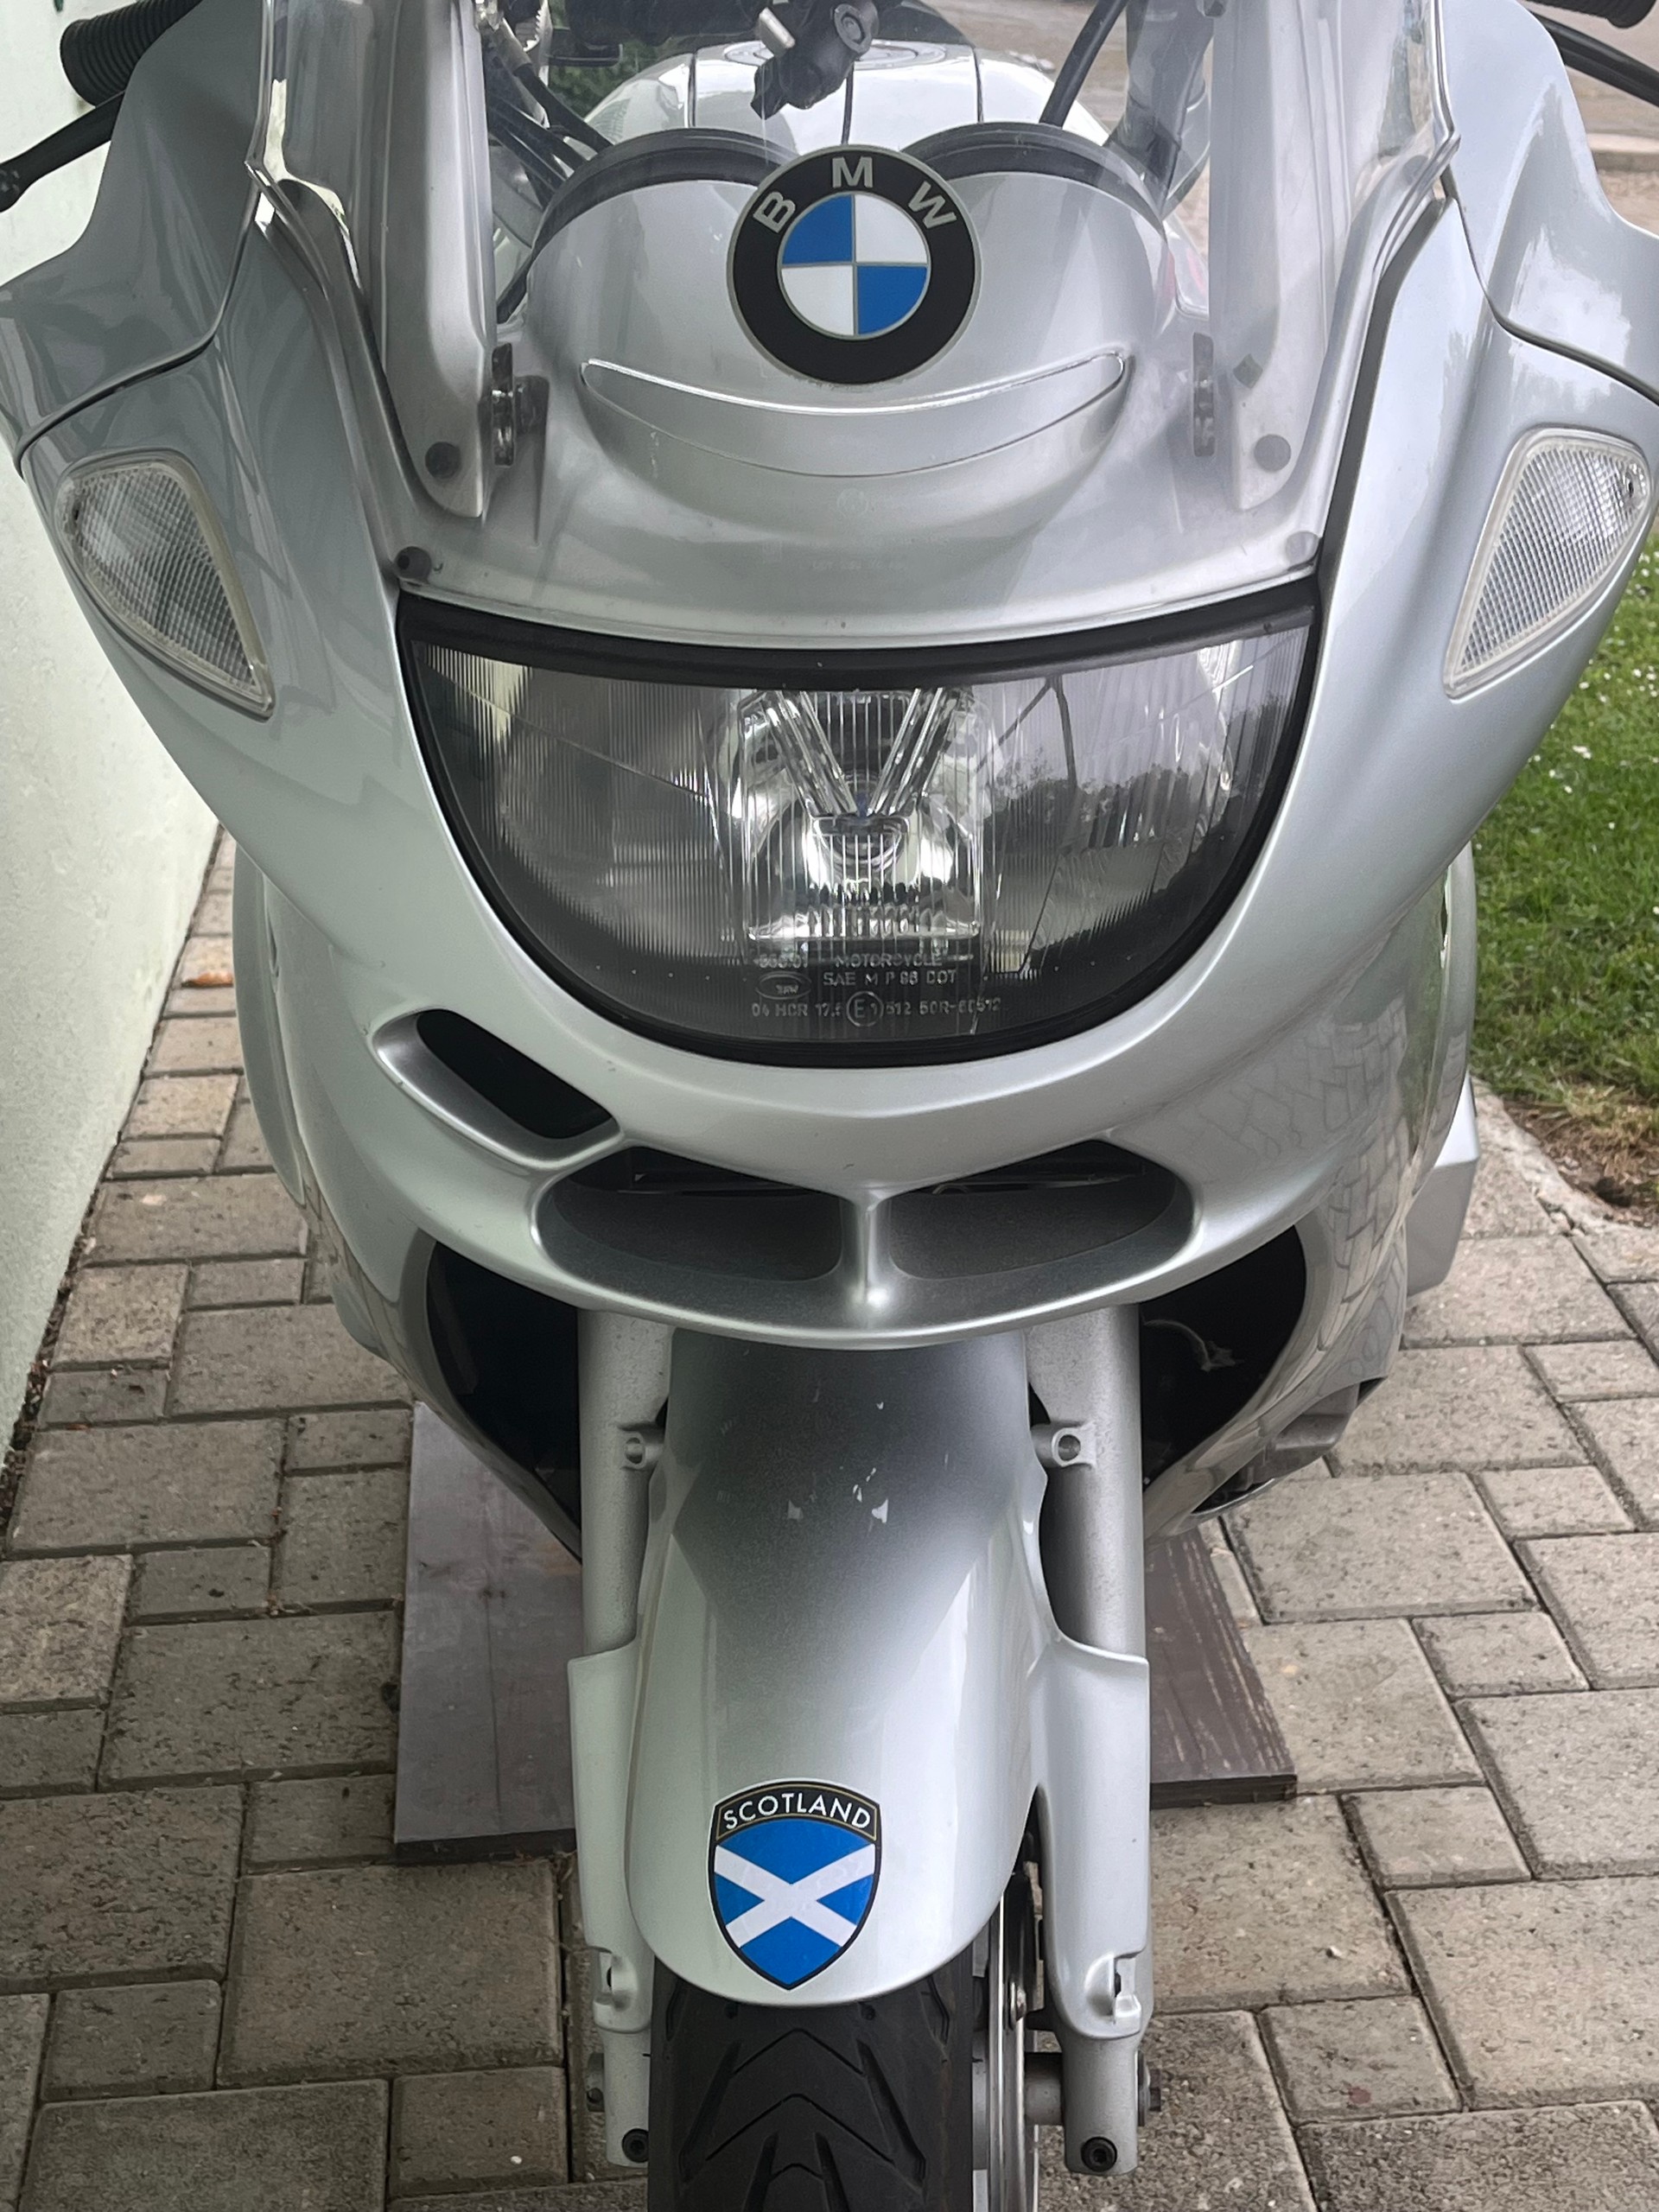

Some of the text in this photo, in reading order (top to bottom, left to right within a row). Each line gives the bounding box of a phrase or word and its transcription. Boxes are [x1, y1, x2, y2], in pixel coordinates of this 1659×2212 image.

[753, 156, 957, 233] BMW
[835, 953, 943, 968] MOTORCYCLE
[823, 971, 856, 986] SAE
[926, 969, 957, 985] DOT
[774, 1002, 809, 1017] HCR
[723, 1792, 871, 1829] SCOTLAND
